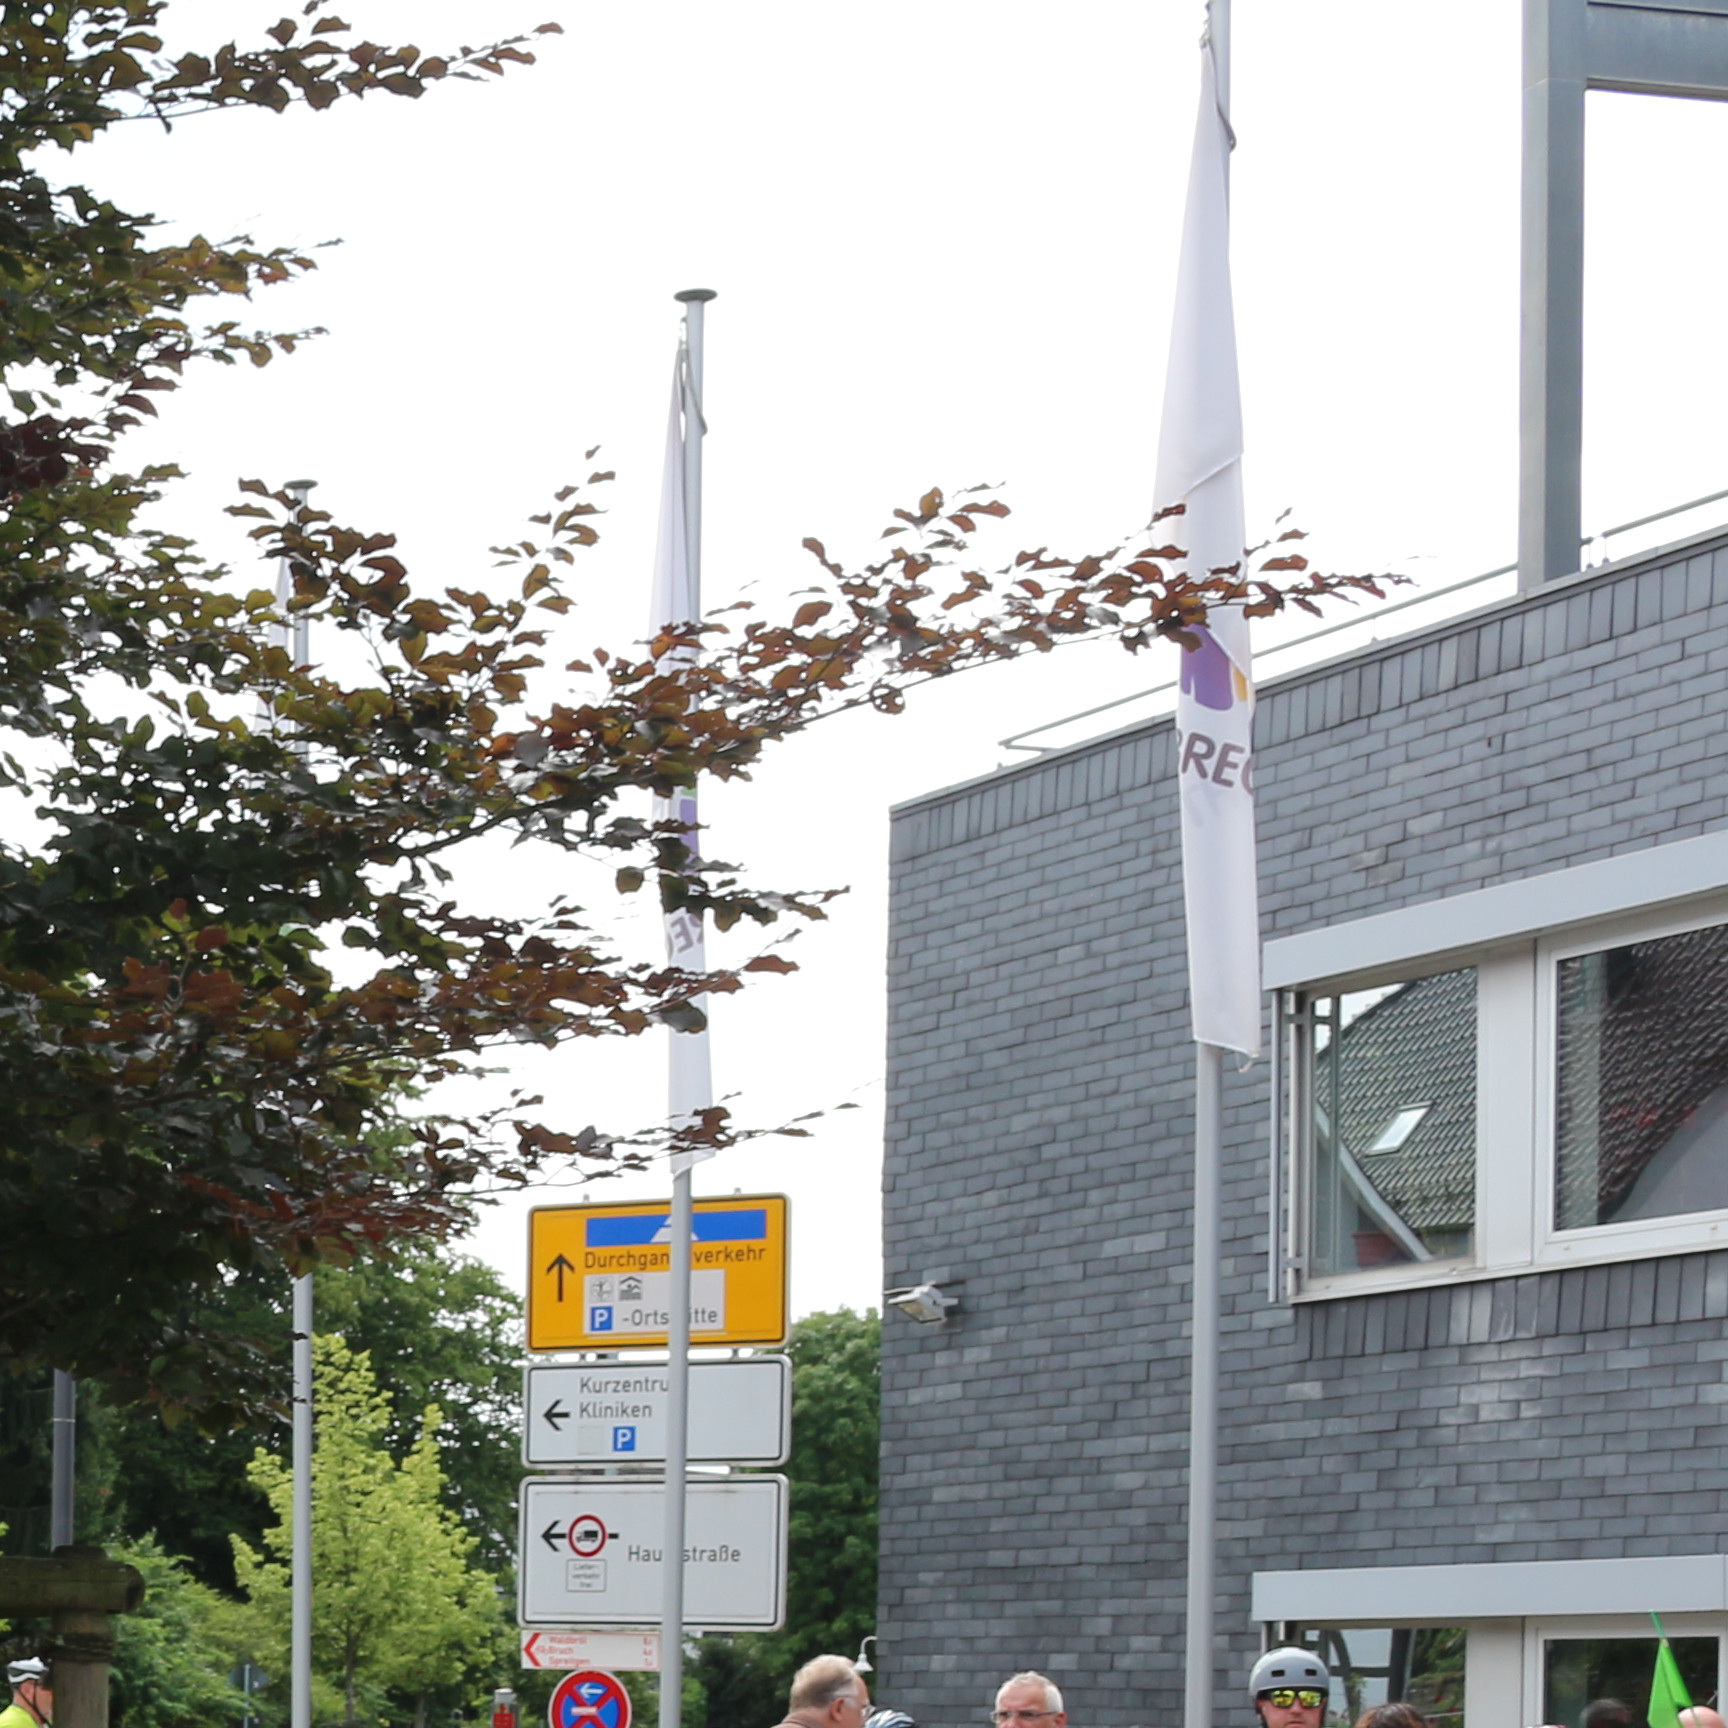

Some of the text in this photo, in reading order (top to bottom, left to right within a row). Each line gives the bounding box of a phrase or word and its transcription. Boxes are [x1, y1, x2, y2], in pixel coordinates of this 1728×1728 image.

[585, 1245, 767, 1270] Durchganverkehr
[622, 1307, 718, 1326] -Ortsitte
[579, 1376, 669, 1393] Kurzentru
[579, 1402, 652, 1419] Kliniken
[628, 1545, 741, 1563] Haustraße
